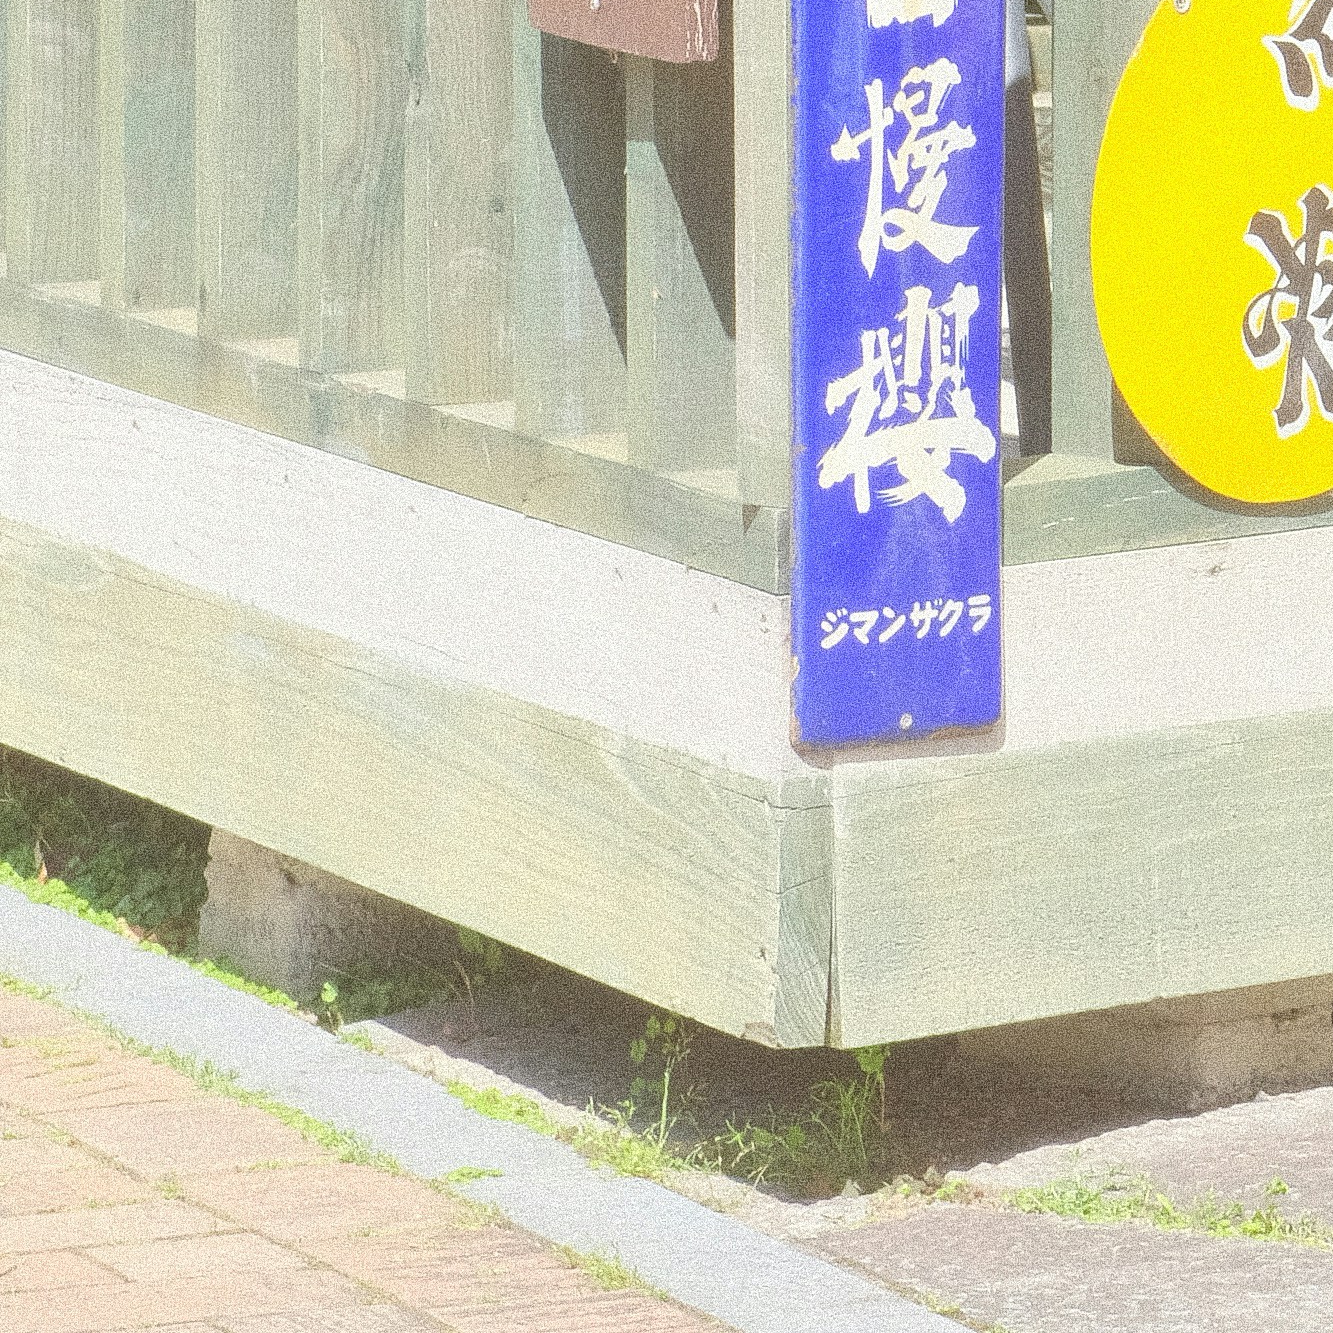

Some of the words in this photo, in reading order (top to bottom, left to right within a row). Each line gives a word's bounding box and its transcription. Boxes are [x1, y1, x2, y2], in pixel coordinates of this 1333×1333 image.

[820, 593, 992, 649] ジマンザクラ
